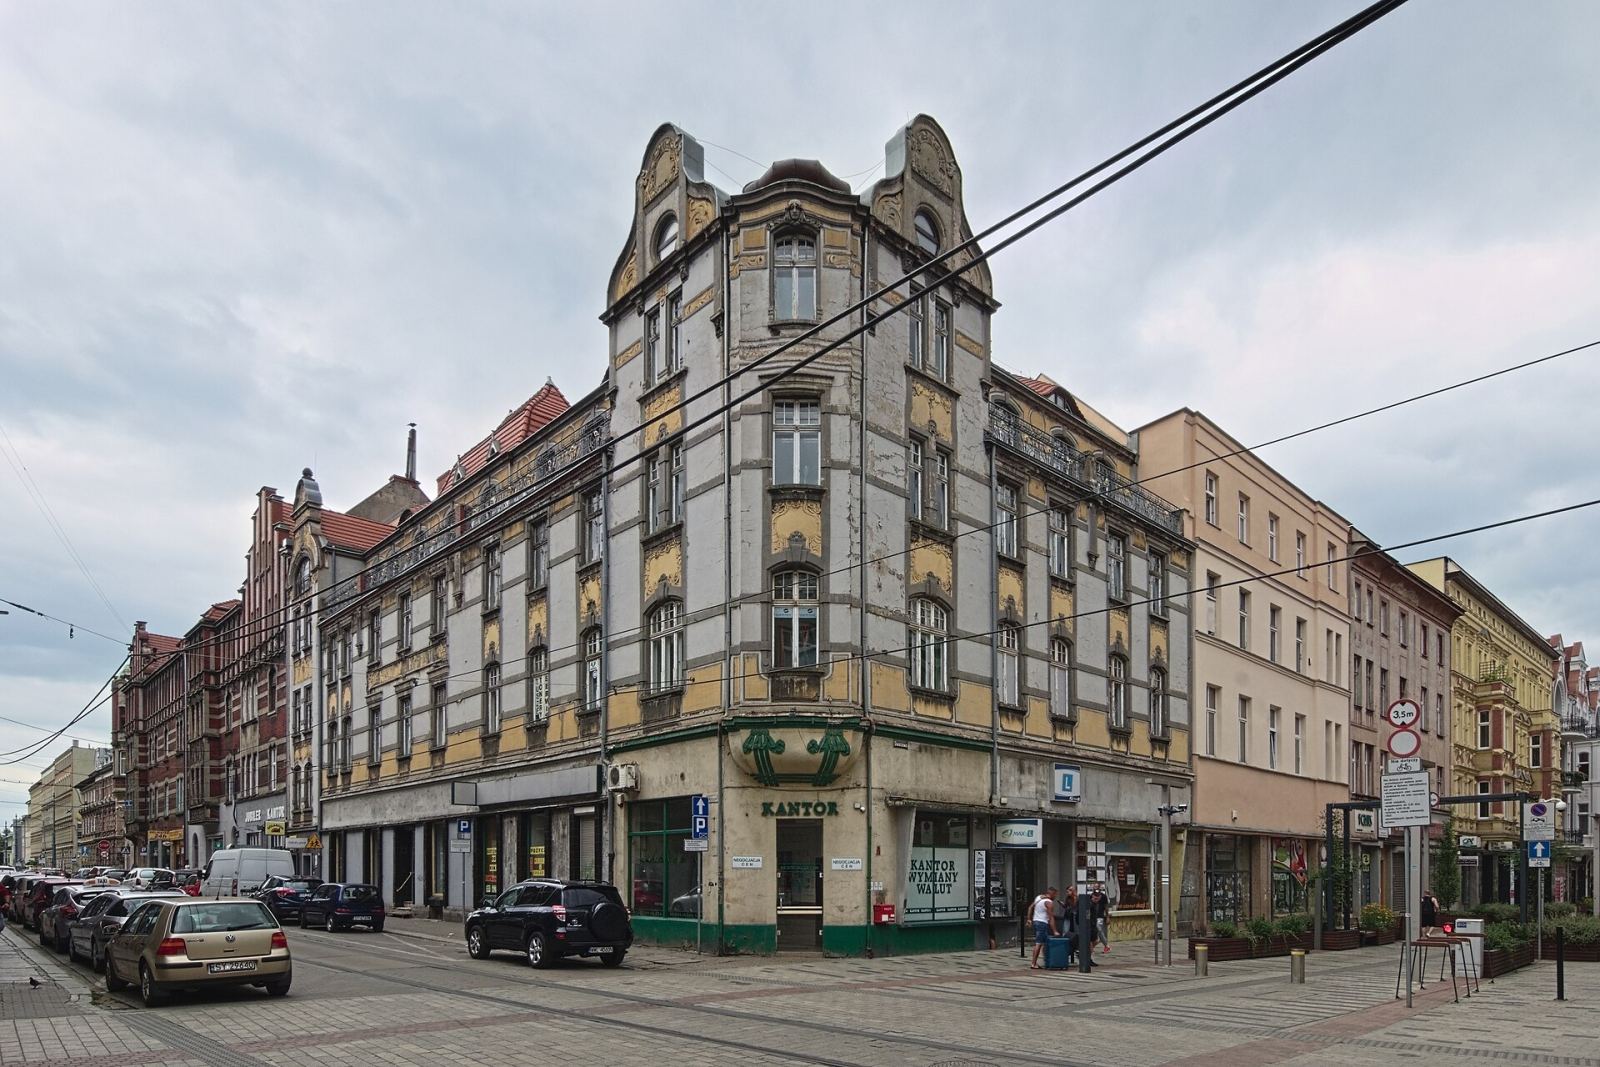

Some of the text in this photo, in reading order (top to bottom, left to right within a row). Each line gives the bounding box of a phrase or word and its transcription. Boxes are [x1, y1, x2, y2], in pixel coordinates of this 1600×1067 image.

[761, 801, 839, 817] KANTOR
[460, 820, 469, 831] P
[696, 818, 706, 833] P
[911, 860, 955, 871] KANTOR
[909, 872, 958, 883] WYMIANY
[917, 884, 952, 895] WALUT
